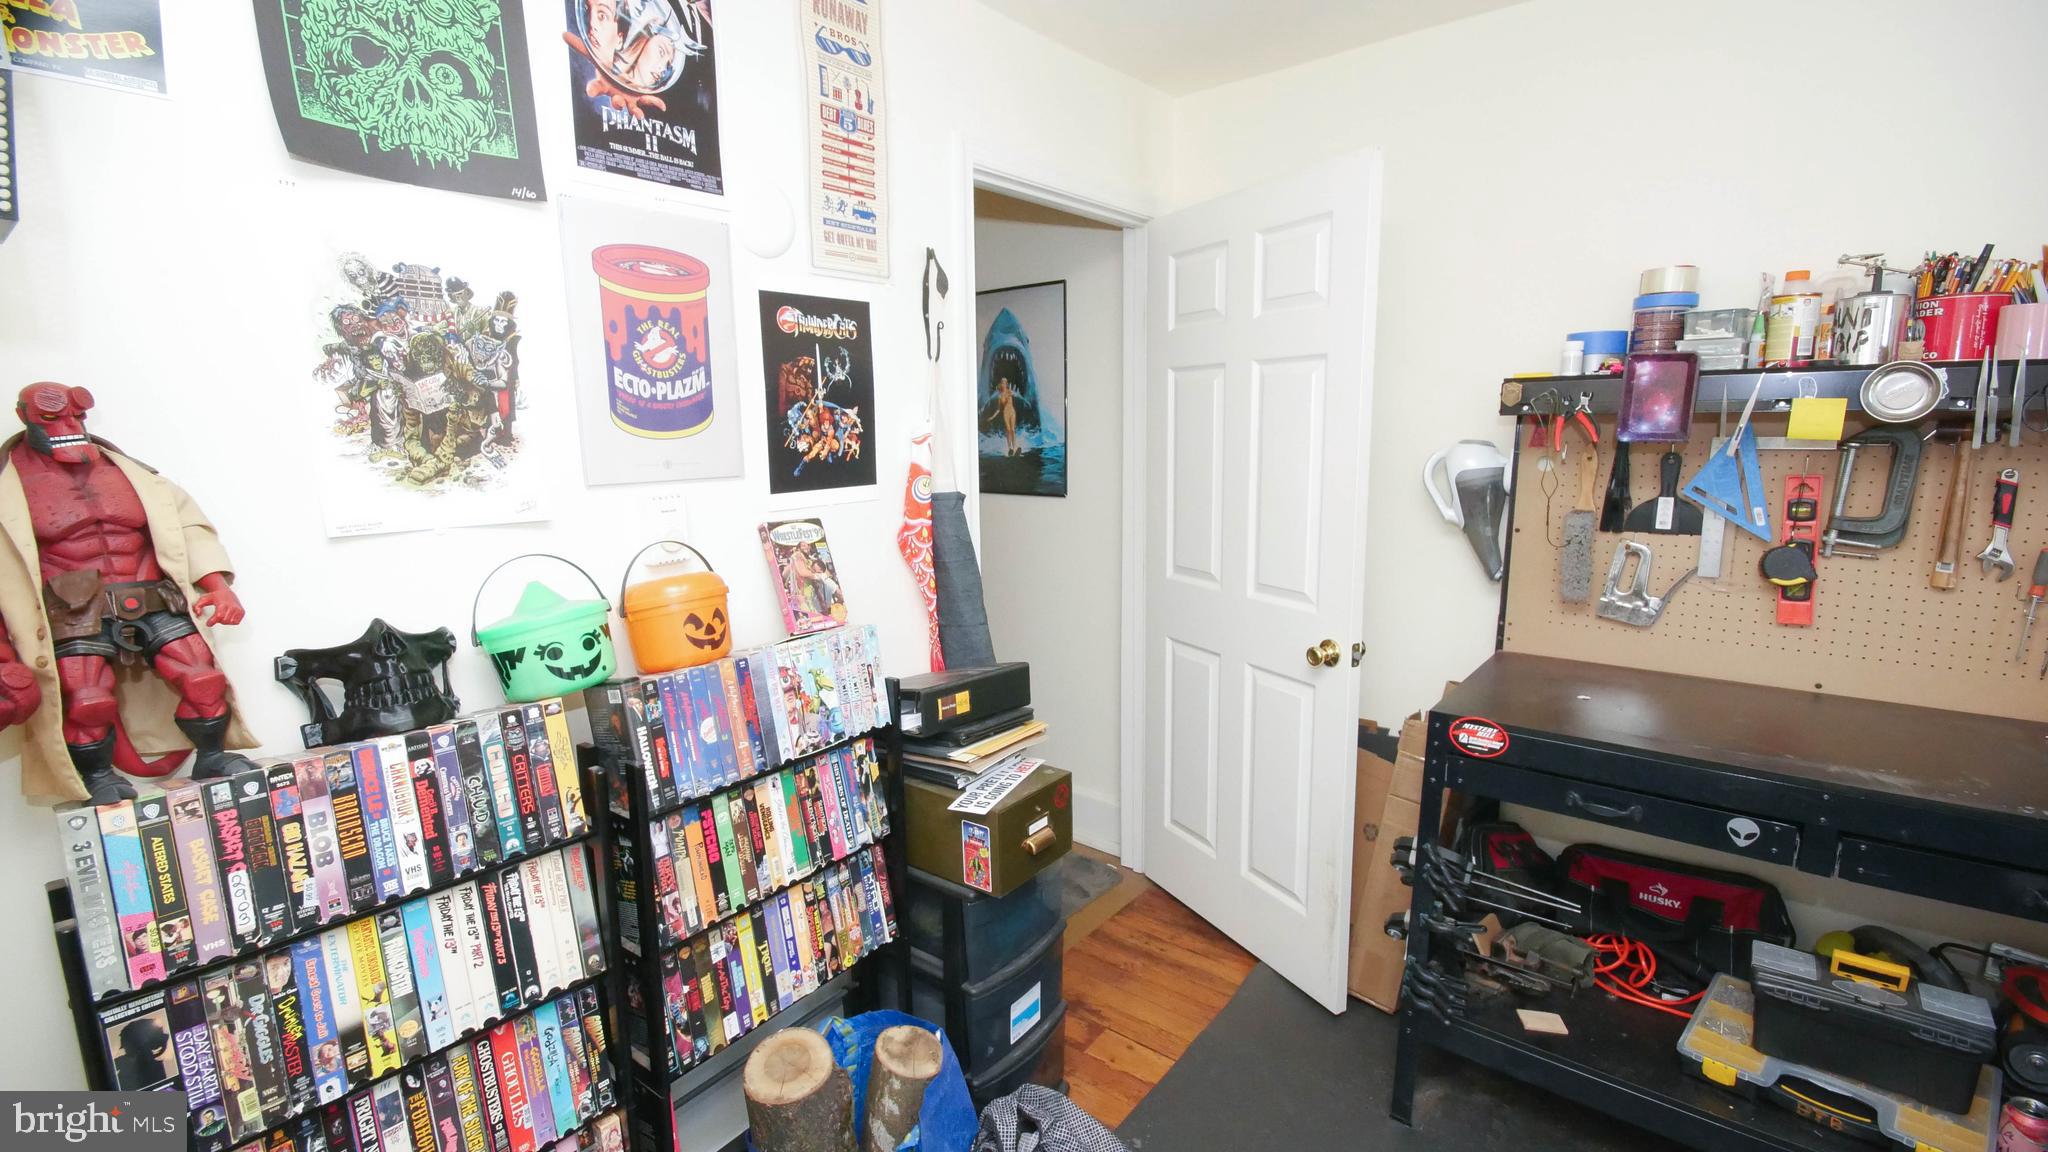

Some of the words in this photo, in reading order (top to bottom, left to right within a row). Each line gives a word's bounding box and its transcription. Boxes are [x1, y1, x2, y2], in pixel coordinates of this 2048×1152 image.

[829, 28, 857, 46] BROS
[601, 105, 698, 156] PHANTASM
[645, 133, 660, 153] II
[512, 186, 537, 199] 14/60
[637, 320, 653, 334] THE
[657, 319, 680, 340] REAL
[1462, 722, 1499, 733] MYSTERY
[1476, 730, 1495, 739] HILL
[407, 742, 428, 751] ARTISAN
[638, 728, 657, 790] HALLOWEEN
[390, 764, 414, 818] CARNOSAUR
[439, 768, 450, 795] CHRISTMAS
[445, 795, 454, 816] VACATION
[488, 747, 514, 818] CONGO
[514, 755, 535, 815] CRITTERS
[834, 765, 845, 796] SISTERS
[974, 800, 991, 809] IS
[983, 780, 1012, 801] GOING
[1005, 773, 1022, 785] TO
[1014, 761, 1037, 774] HELL
[416, 782, 436, 839] Demented
[427, 789, 436, 807] Cecil
[469, 777, 491, 829] C.H.U.D.
[839, 796, 848, 809] OF
[954, 791, 979, 808] YOUR
[283, 823, 301, 844] BIO
[335, 795, 366, 859] BRAINSCAN
[370, 821, 380, 835] THE
[760, 805, 770, 840] VENGEANCE
[765, 808, 774, 832] ROLLING
[843, 811, 853, 839] DEATH
[71, 840, 92, 854] 3
[212, 810, 246, 862] BASKET
[309, 812, 335, 868] BLOB
[379, 819, 391, 842] BRUCE
[385, 844, 396, 867] TAKES
[701, 811, 720, 863] PSYCHO
[151, 837, 168, 873] ALTERED
[187, 839, 213, 886] BASKET
[373, 836, 387, 869] DRAGON
[76, 854, 100, 893] EVIL
[404, 864, 422, 876] VHS
[528, 861, 541, 884] FRIDAY
[159, 874, 175, 904] STATES
[460, 886, 475, 912] FRIDAY
[482, 883, 500, 912] FRIDAY
[507, 873, 521, 897] FRIDAY
[533, 883, 542, 896] THE
[198, 889, 220, 925] CASE
[437, 896, 453, 924] FRIDAY
[512, 896, 523, 909] THE
[535, 895, 545, 910] 13TH
[1639, 892, 1682, 910] HUSKY
[351, 922, 360, 937] OF
[466, 913, 476, 926] THE
[514, 908, 526, 923] 13TH
[360, 920, 375, 951] FANTASTIC
[443, 924, 455, 938] THE
[469, 926, 479, 941] 13TH
[812, 911, 825, 949] WRESTLING
[203, 938, 226, 951] VHS
[355, 939, 363, 955] THE
[445, 938, 458, 955] 13TH
[472, 943, 484, 962] PART
[493, 938, 504, 958] PART
[758, 941, 774, 976] TROLL
[328, 937, 348, 1005] EXTERMINATOR
[359, 958, 370, 987] MOVIES
[367, 952, 382, 984] DINOSAURS
[384, 939, 413, 998] FRANKENSTEIN
[473, 961, 485, 969] 2
[497, 957, 507, 965] 3
[192, 1031, 212, 1057] DAY
[251, 1014, 279, 1065] GIGGLES
[564, 1027, 585, 1066] GODZILLA
[585, 1016, 606, 1055] GODZILLA
[175, 1033, 199, 1076] STOOD
[280, 1033, 305, 1078] MASTER
[451, 1055, 472, 1082] FURY
[593, 1049, 602, 1064] KING
[198, 1059, 222, 1099] EARTH
[475, 1043, 507, 1124] GHOSTBUSTERS
[529, 1048, 547, 1093] GODZILLA
[185, 1077, 207, 1108] STILL
[455, 1080, 475, 1096] OF
[500, 1054, 530, 1128] GHOULIES
[353, 1097, 378, 1142] FRIGHT
[459, 1095, 478, 1116] THE
